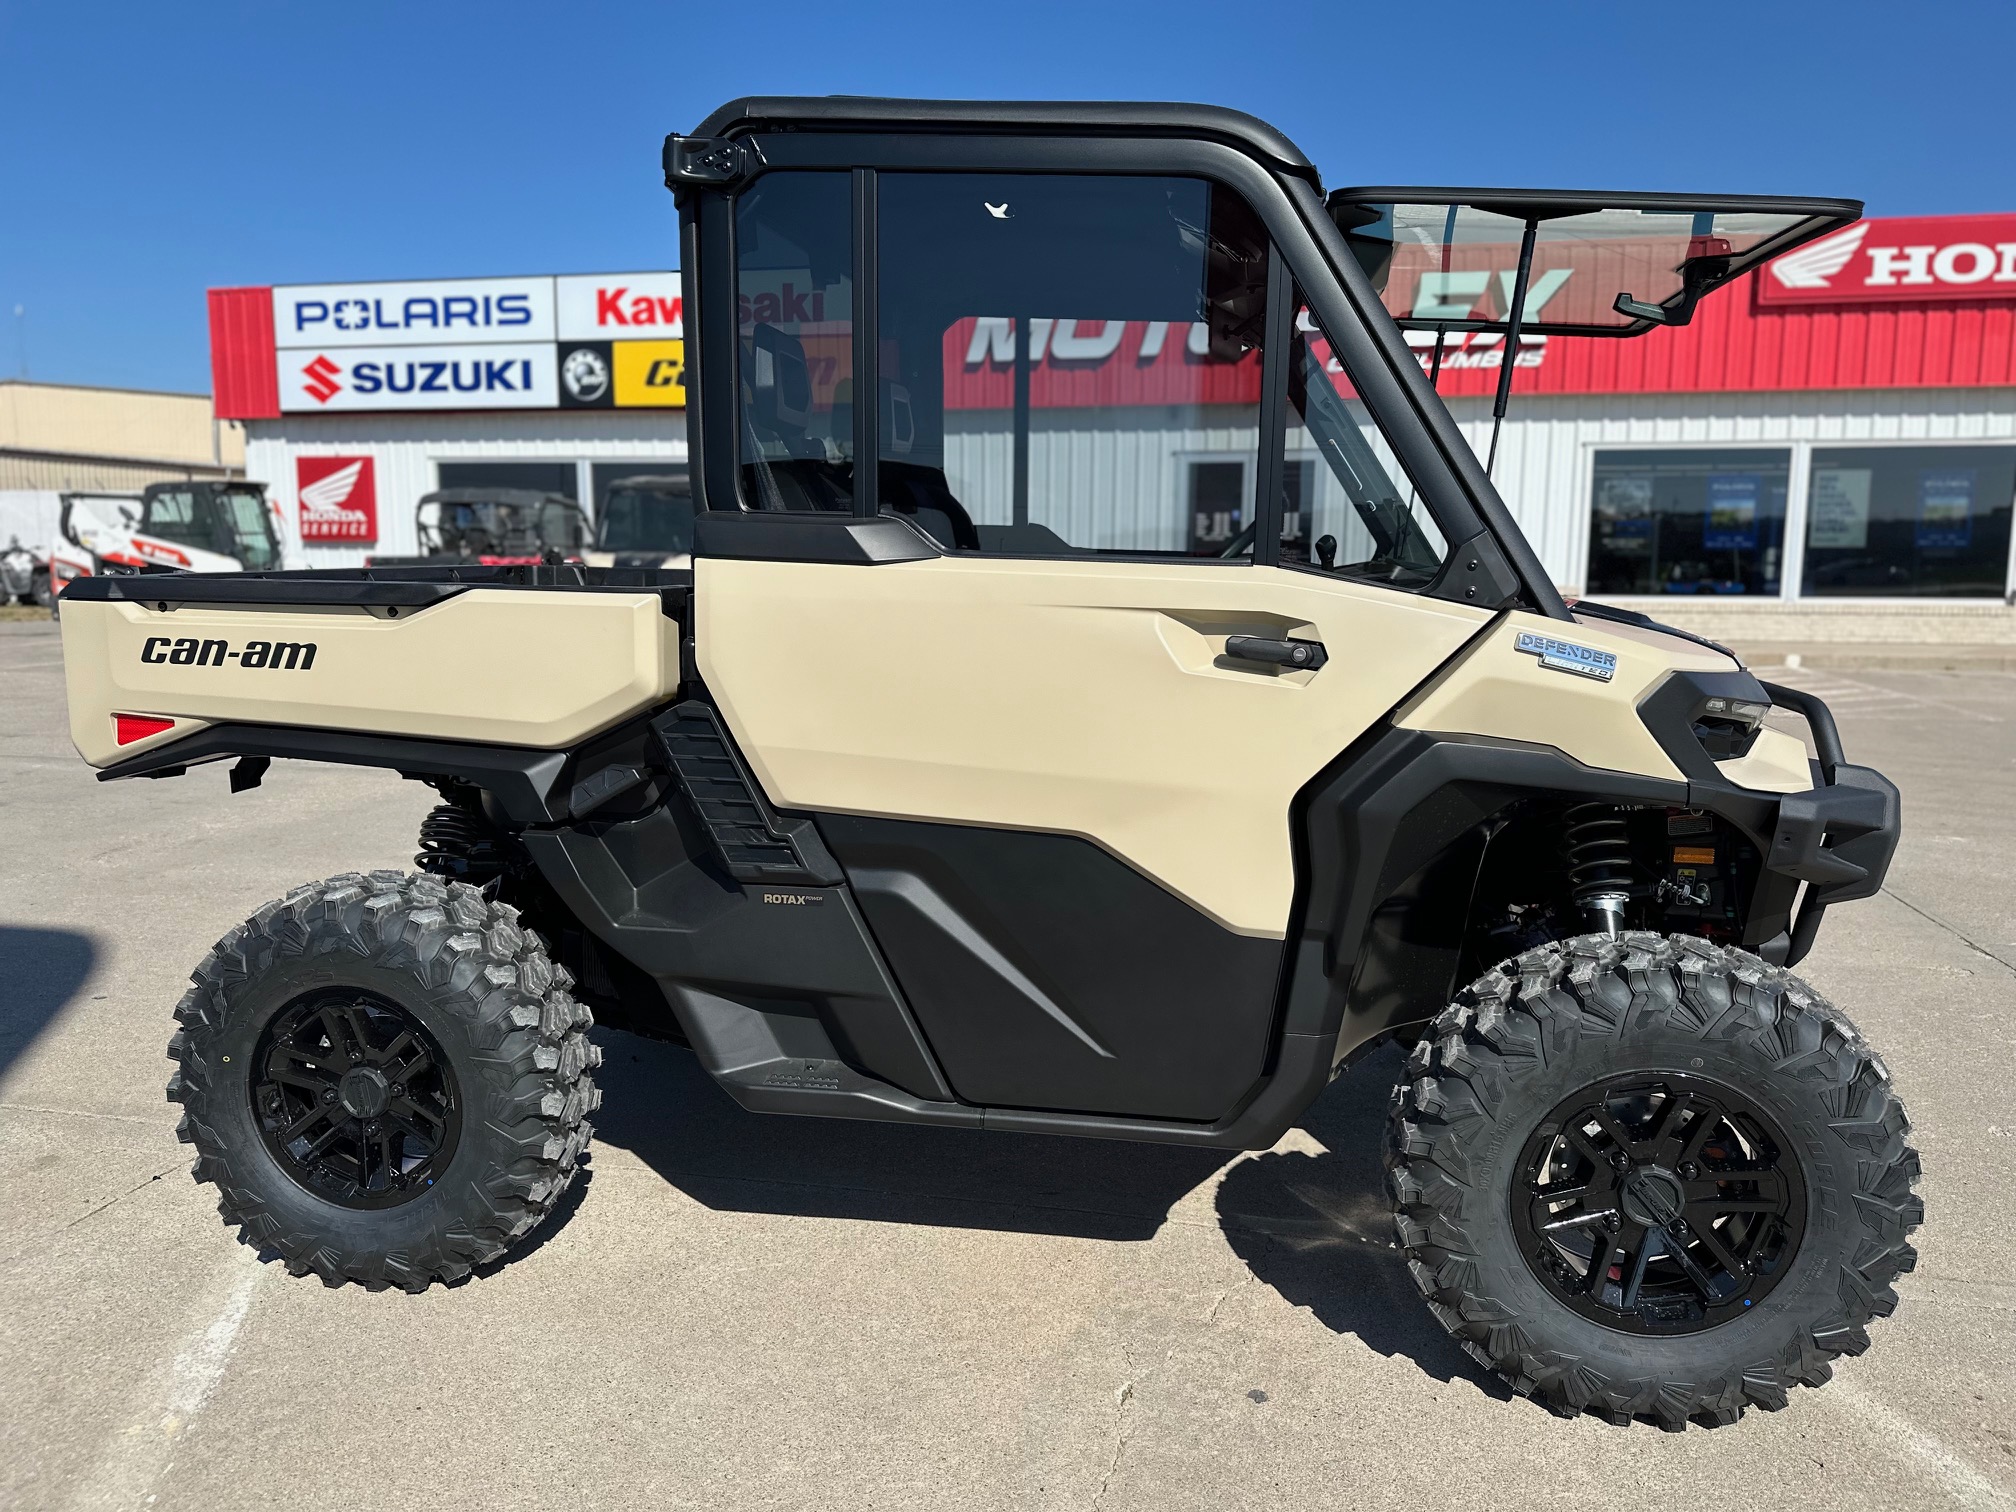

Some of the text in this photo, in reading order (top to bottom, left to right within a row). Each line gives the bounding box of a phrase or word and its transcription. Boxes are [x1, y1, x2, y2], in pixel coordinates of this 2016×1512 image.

[295, 294, 533, 332] POLARIS
[352, 359, 533, 394] SUZUKI
[301, 509, 368, 523] HONDA
[302, 521, 368, 536] SERVICE
[140, 637, 318, 671] can-am
[1521, 635, 1615, 667] DEFENDER
[763, 893, 806, 905] ROTAX
